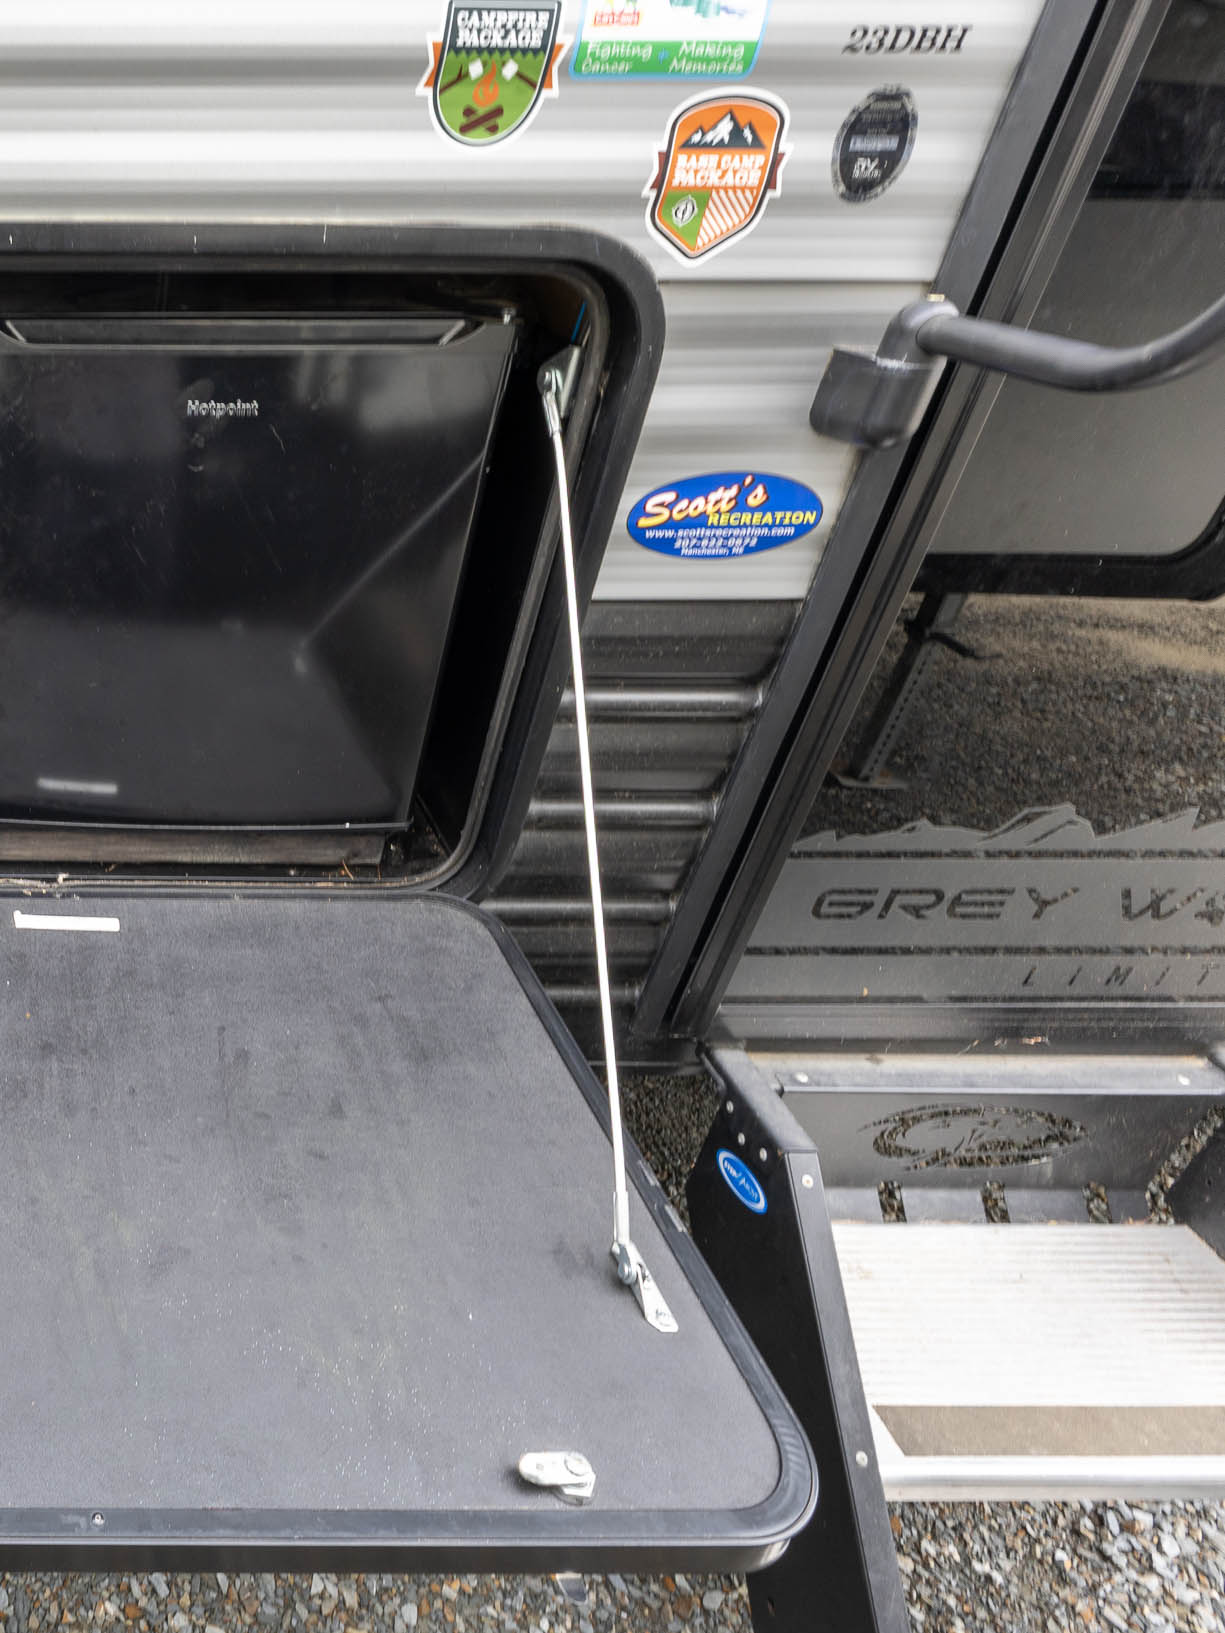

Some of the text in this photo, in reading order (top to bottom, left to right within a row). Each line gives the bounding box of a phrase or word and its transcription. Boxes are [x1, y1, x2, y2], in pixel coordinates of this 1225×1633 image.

[456, 10, 550, 30] CAMPFIRE
[456, 29, 544, 48] PACKAGE
[841, 23, 973, 55] 23DBH
[587, 40, 653, 60] Fighting
[679, 41, 745, 60] Making
[581, 57, 633, 73] Cancer
[669, 57, 744, 73] Memories
[676, 154, 766, 169] BASE CAMP
[672, 168, 762, 187] PACKAGE
[187, 399, 259, 420] Hotpoint
[637, 474, 770, 528] Scott's
[707, 511, 818, 527] RECREATION
[645, 526, 796, 539] www.scottsrecreation.com
[811, 887, 1079, 921] GREY
